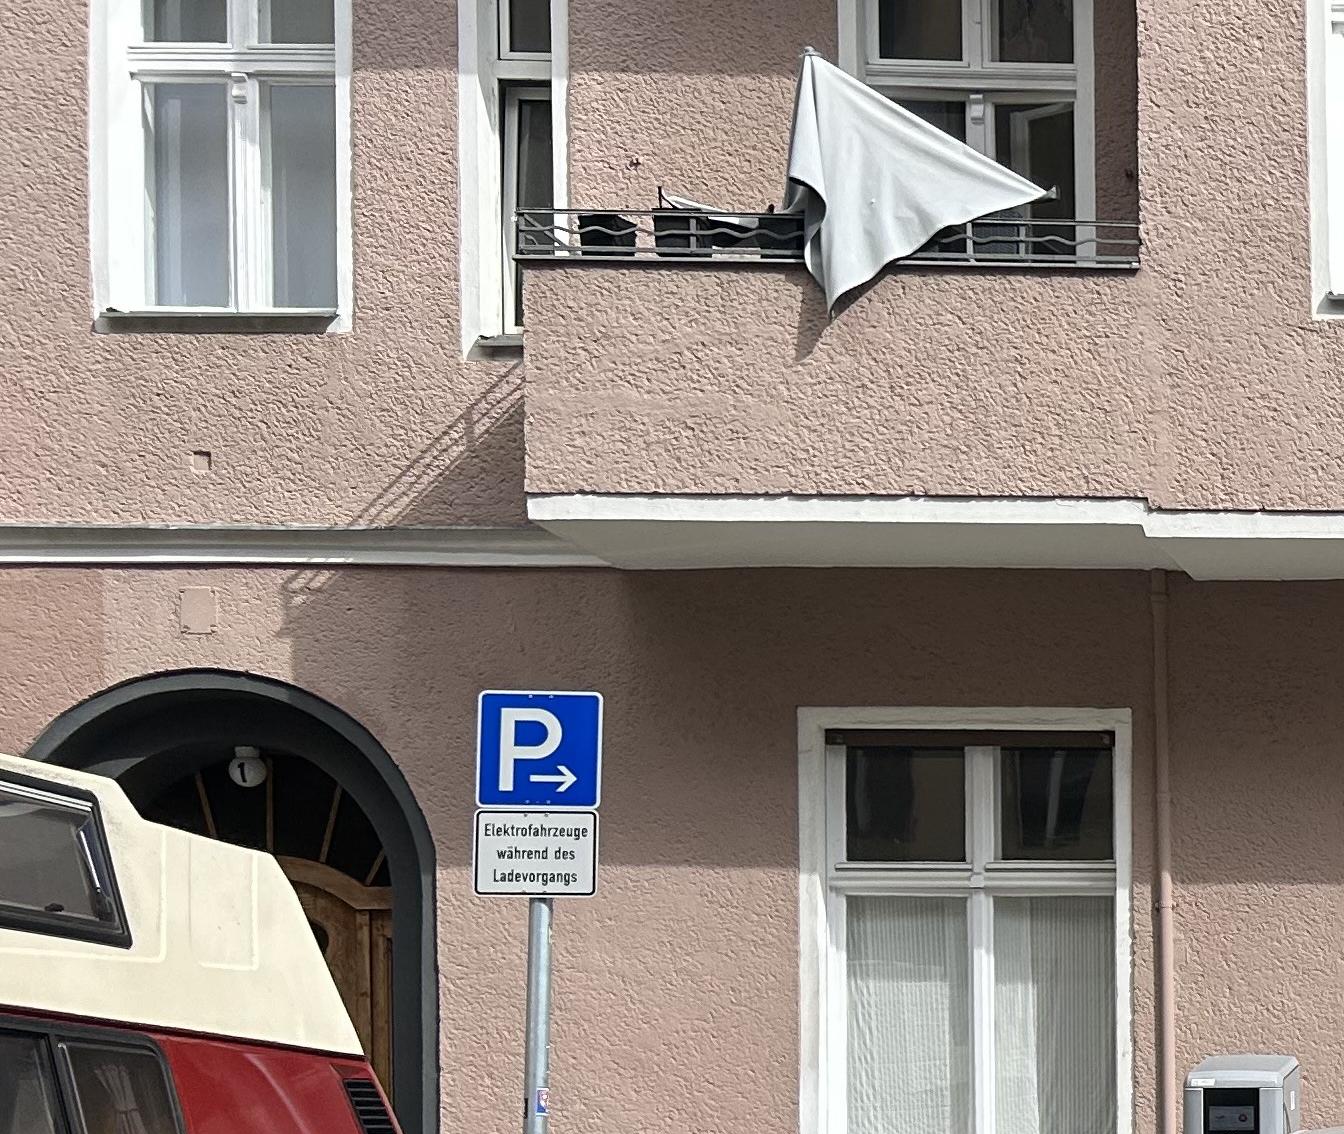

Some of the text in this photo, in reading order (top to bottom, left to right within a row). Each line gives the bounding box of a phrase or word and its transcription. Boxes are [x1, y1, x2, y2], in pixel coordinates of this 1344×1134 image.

[498, 708, 563, 792] P
[484, 823, 589, 841] Elektrofahrzeuge
[496, 846, 576, 860] während des
[493, 869, 578, 886] Ladevorgangs
